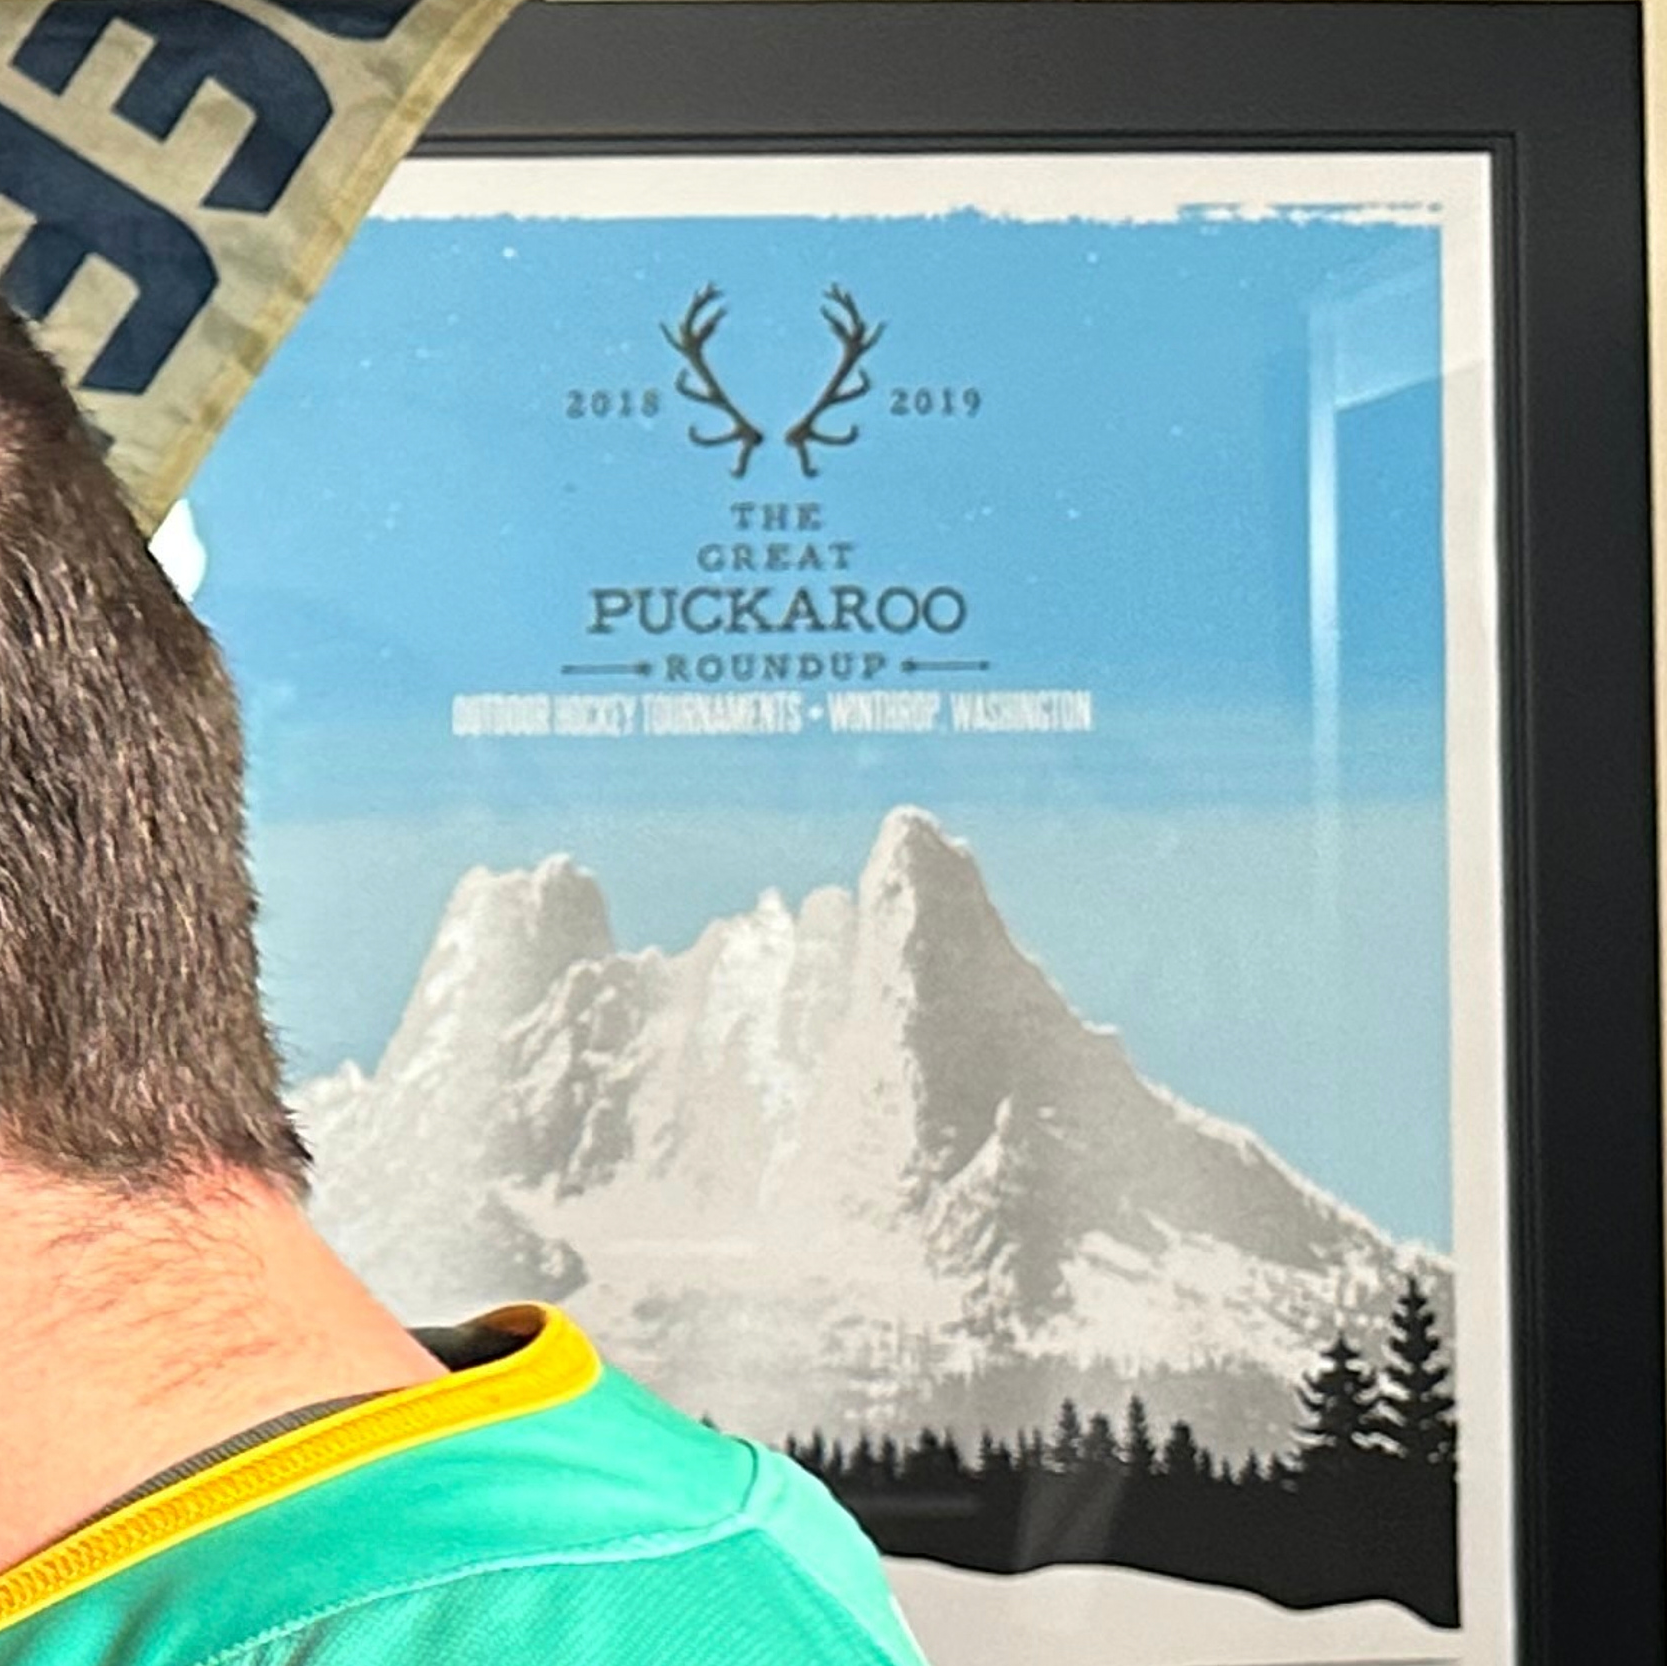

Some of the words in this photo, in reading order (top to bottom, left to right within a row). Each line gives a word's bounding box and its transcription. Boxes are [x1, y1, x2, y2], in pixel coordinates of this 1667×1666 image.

[566, 389, 661, 418] 2018
[889, 388, 982, 417] 2019
[730, 503, 822, 532] THE
[697, 543, 855, 572] GREAT
[586, 585, 968, 635] PUCKAROO
[667, 653, 888, 683] ROUNDUP
